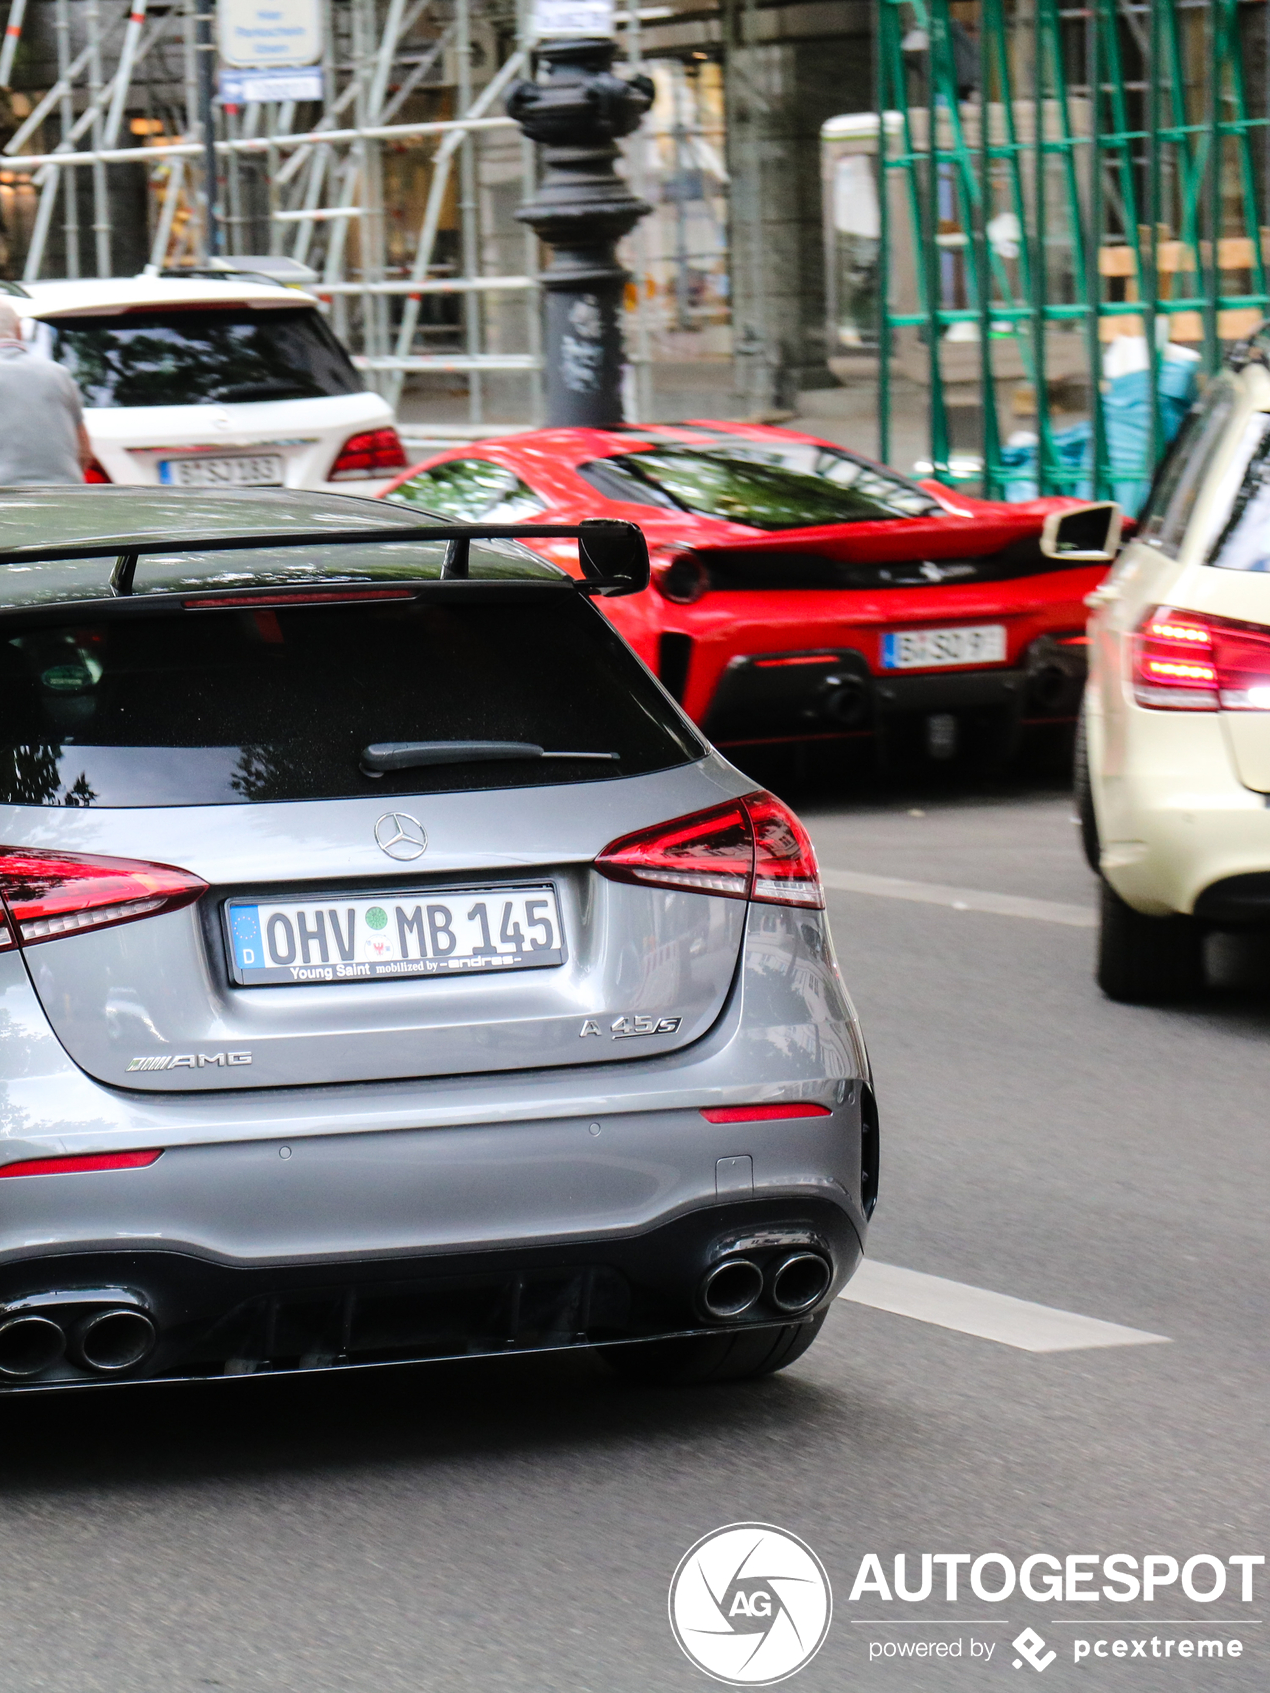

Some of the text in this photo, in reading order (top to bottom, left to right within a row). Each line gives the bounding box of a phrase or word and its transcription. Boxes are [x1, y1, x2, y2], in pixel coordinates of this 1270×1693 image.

[266, 899, 554, 965] OHV MB 145
[242, 949, 255, 964] D
[290, 966, 333, 980] Young
[336, 963, 370, 976] Saint
[376, 961, 424, 974] mobilized
[426, 959, 438, 972] by
[579, 1019, 603, 1038] A
[166, 1051, 253, 1070] AMG
